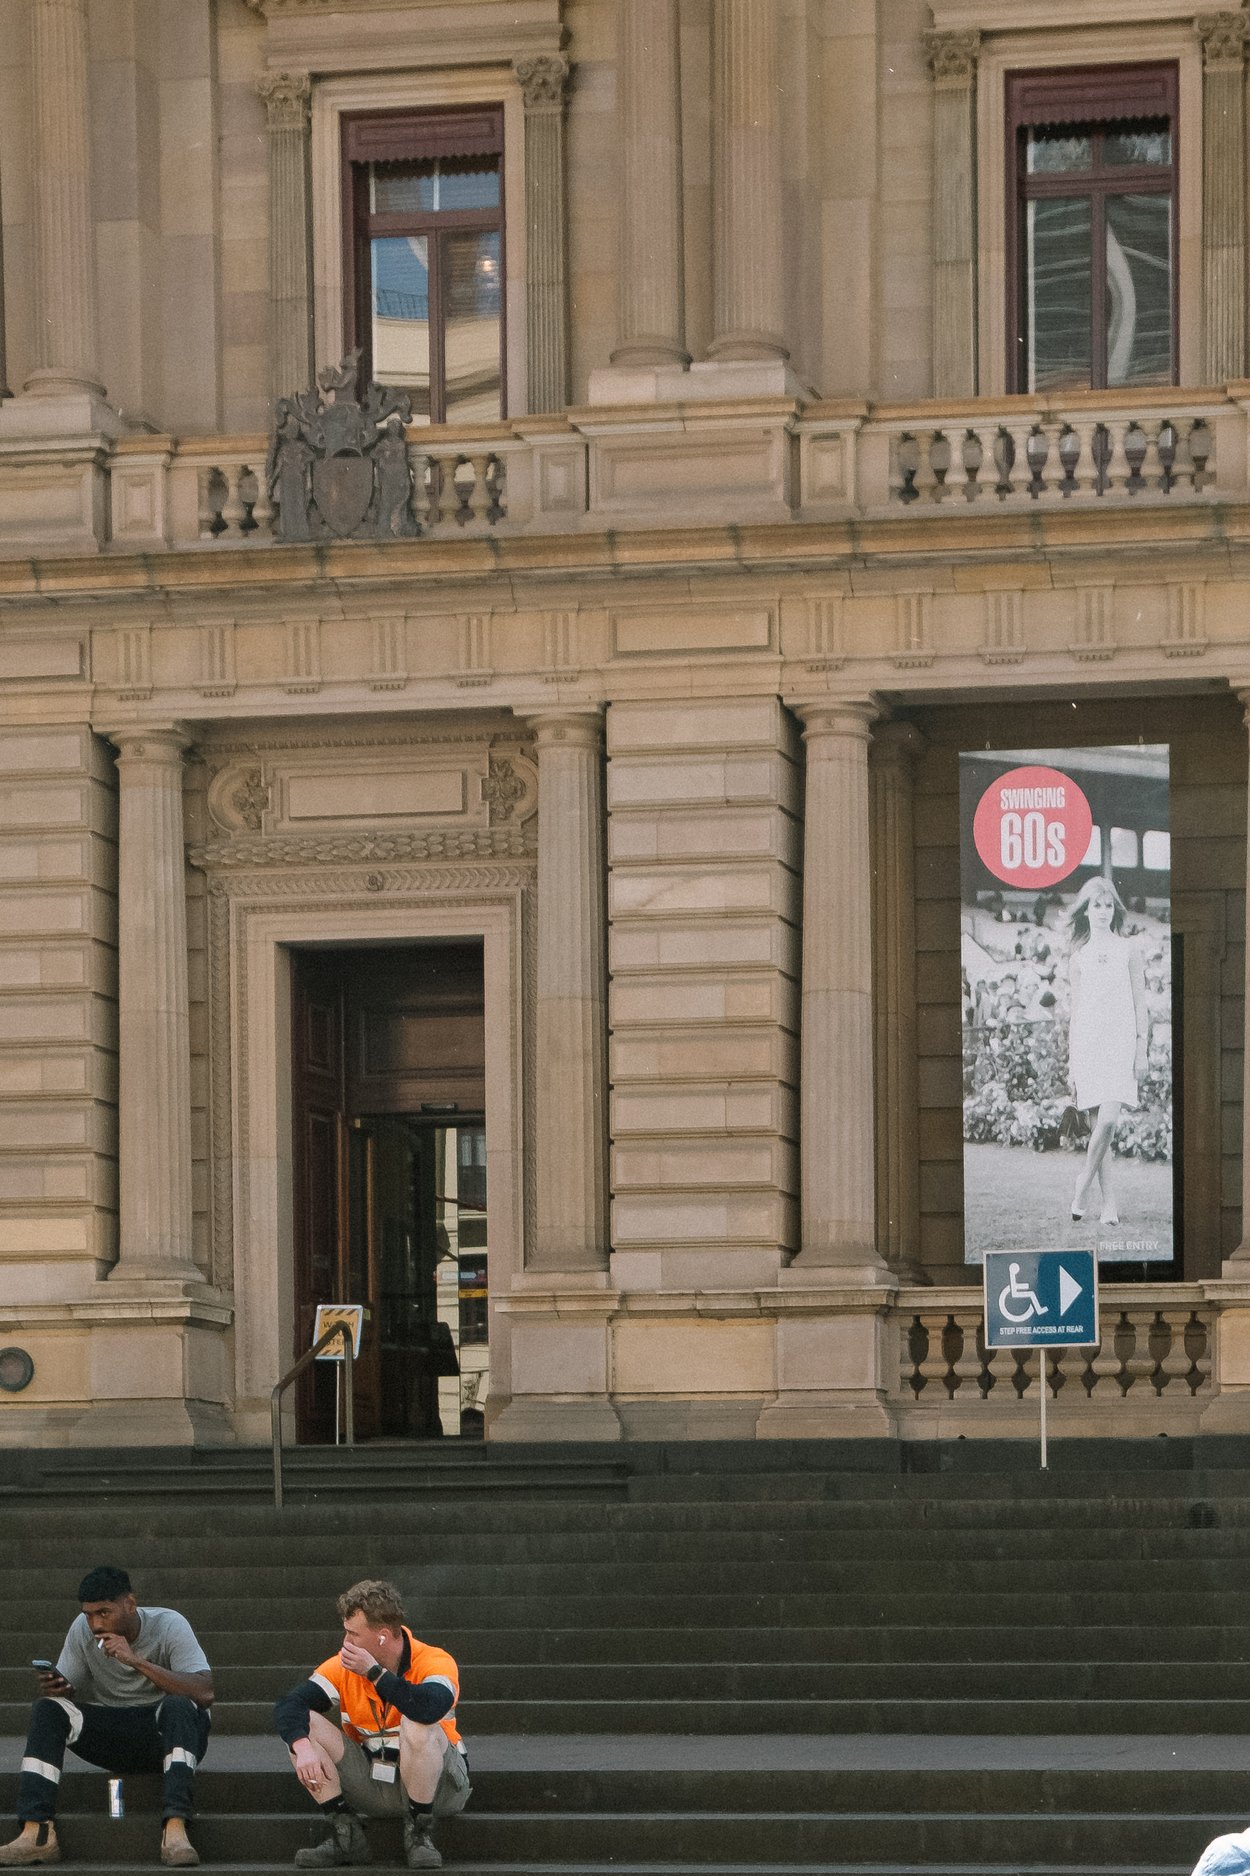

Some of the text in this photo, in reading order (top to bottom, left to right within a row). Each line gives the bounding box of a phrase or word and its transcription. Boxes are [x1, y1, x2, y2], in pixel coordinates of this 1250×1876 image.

[1000, 786, 1066, 810] SWINGING
[1000, 811, 1066, 869] 60s
[1100, 1240, 1159, 1251] FREE ENTRY
[1000, 1324, 1084, 1335] STEP FREE ACCESS AT REAR
